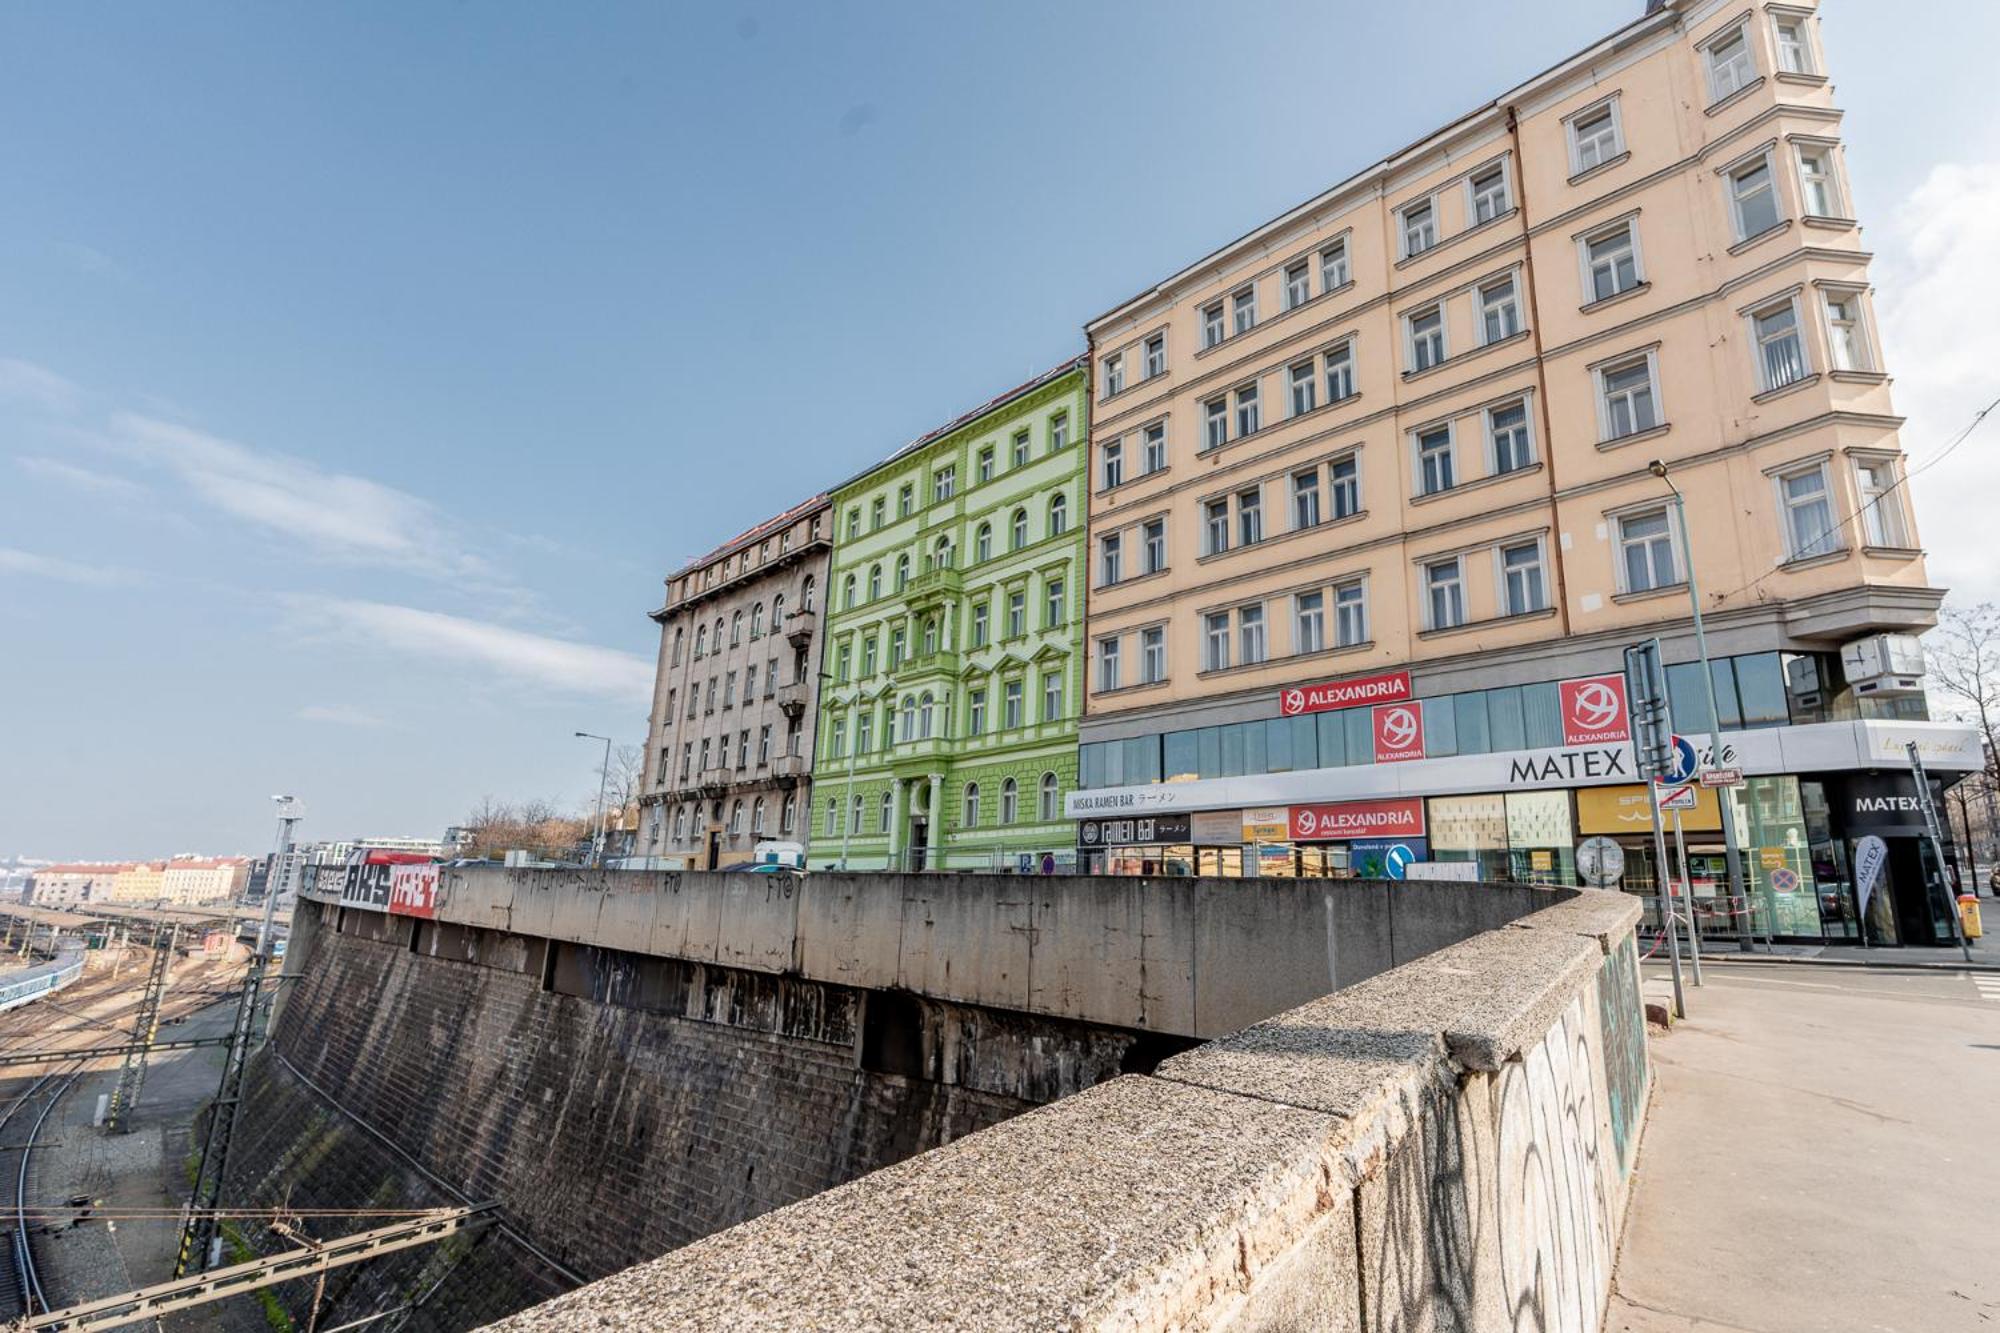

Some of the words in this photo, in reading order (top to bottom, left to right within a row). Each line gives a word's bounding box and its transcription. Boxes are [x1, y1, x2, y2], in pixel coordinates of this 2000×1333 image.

[1309, 679, 1405, 706] ALEXANDRIA
[1568, 731, 1627, 743] ALEXANDRIA
[1377, 750, 1422, 761] ALEXANDRIA
[1510, 749, 1625, 783] MATEX
[1095, 796, 1118, 809] RAMEN
[1120, 794, 1134, 807] BAR
[1856, 797, 1919, 811] MATEX
[1321, 810, 1414, 828] ALEXANDRIA
[1858, 844, 1880, 883] MATEX
